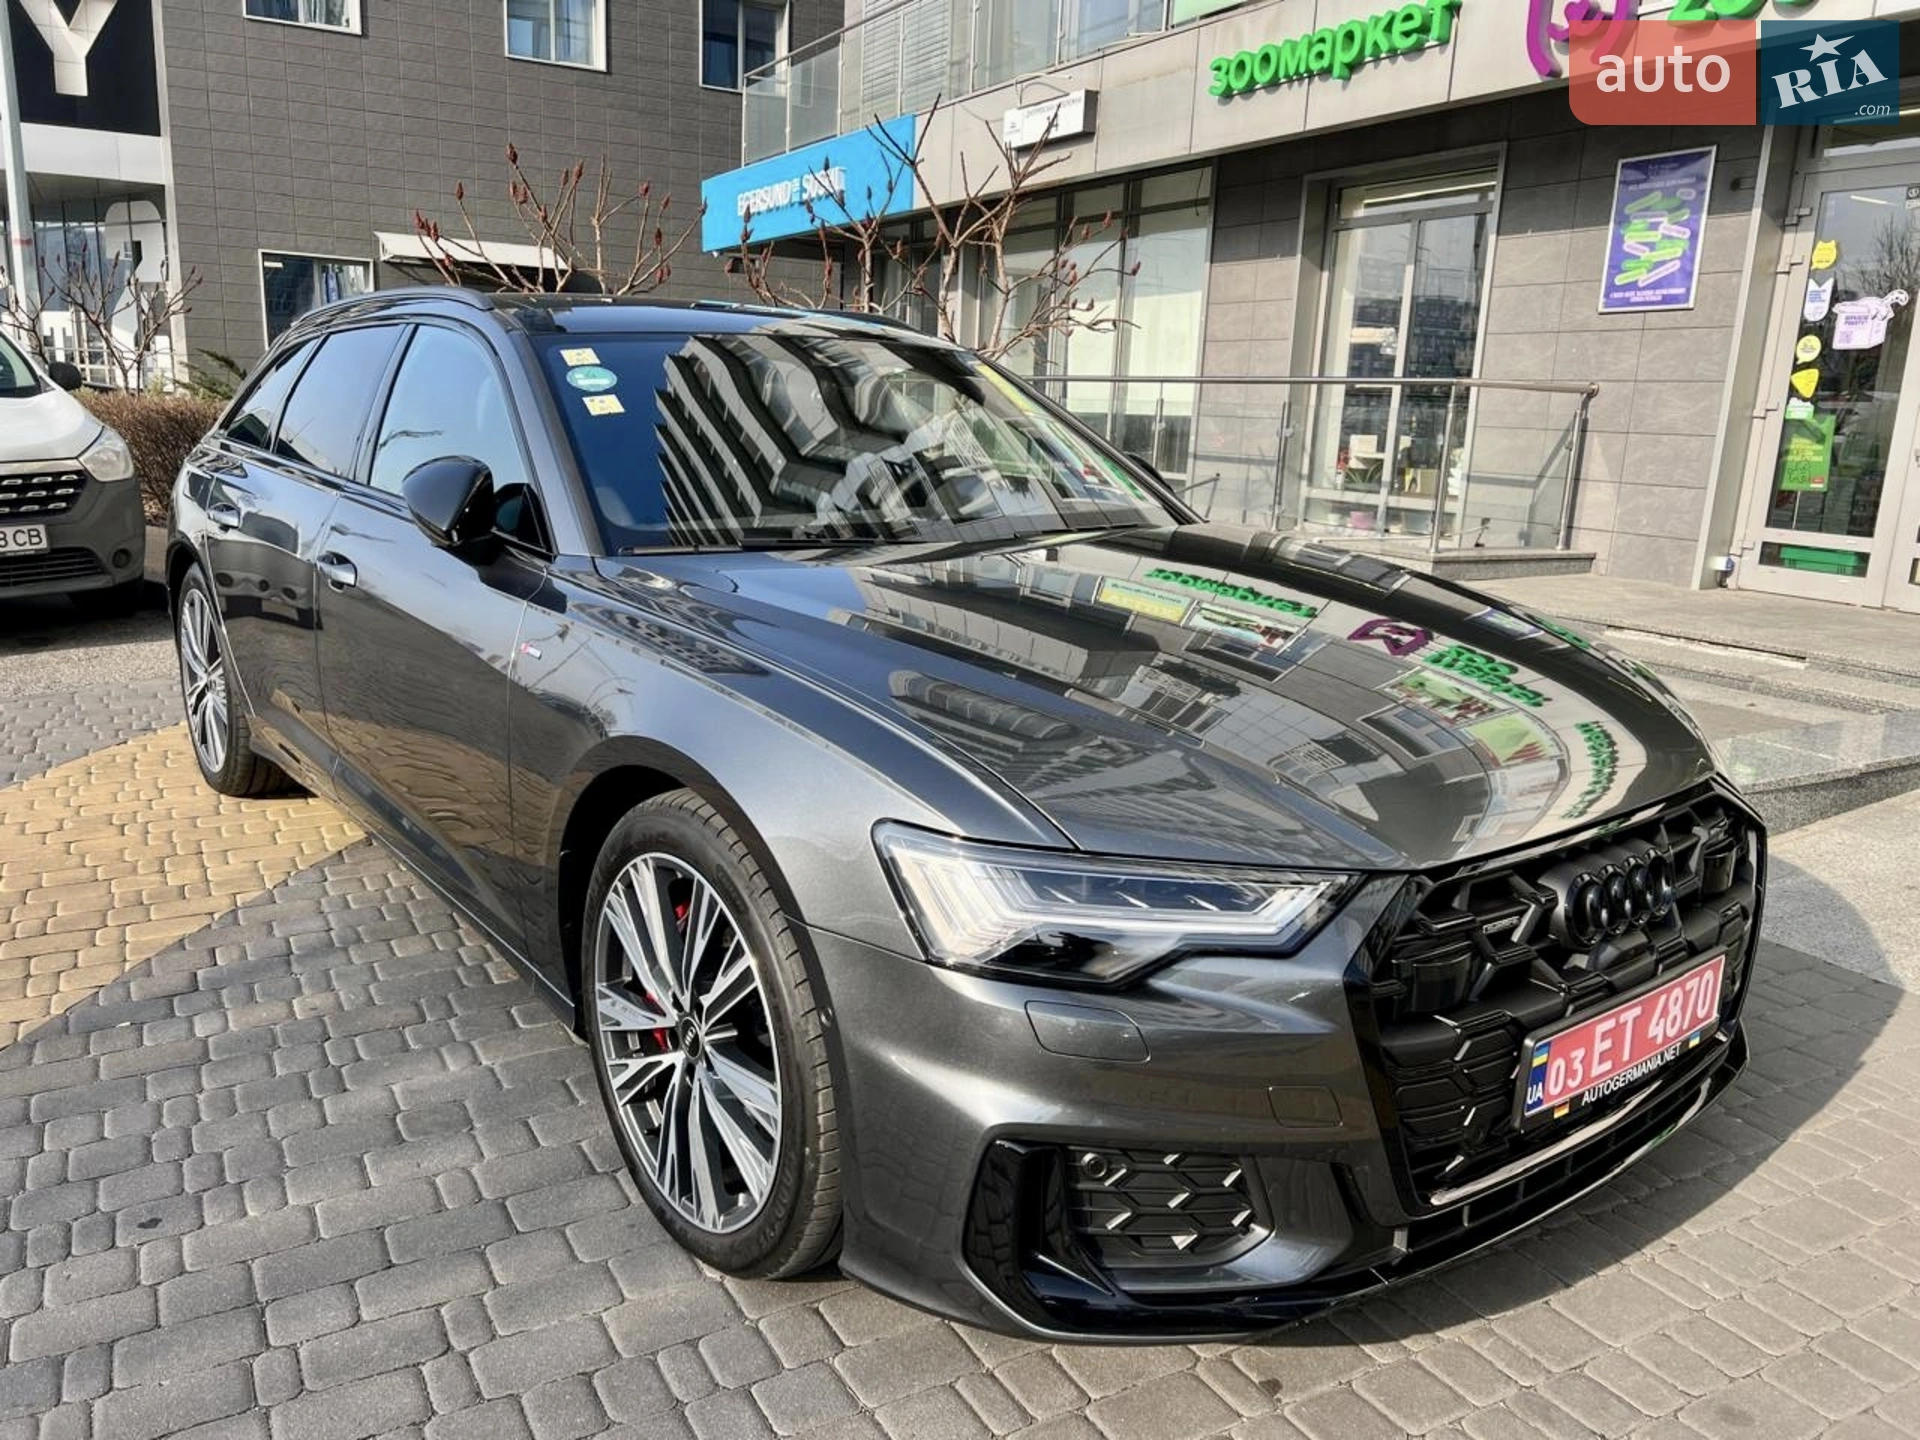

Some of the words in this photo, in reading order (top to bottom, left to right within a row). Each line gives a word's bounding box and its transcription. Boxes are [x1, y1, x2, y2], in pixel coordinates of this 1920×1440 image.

[1208, 0, 1462, 97] зоомаркет
[13, 528, 43, 547] CB
[1547, 1047, 1585, 1096] 03
[1590, 1005, 1643, 1078] ET
[1648, 968, 1715, 1045] 4870
[1527, 1083, 1544, 1104] UA
[1582, 1043, 1682, 1106] AUTOGERMANIA.NET
